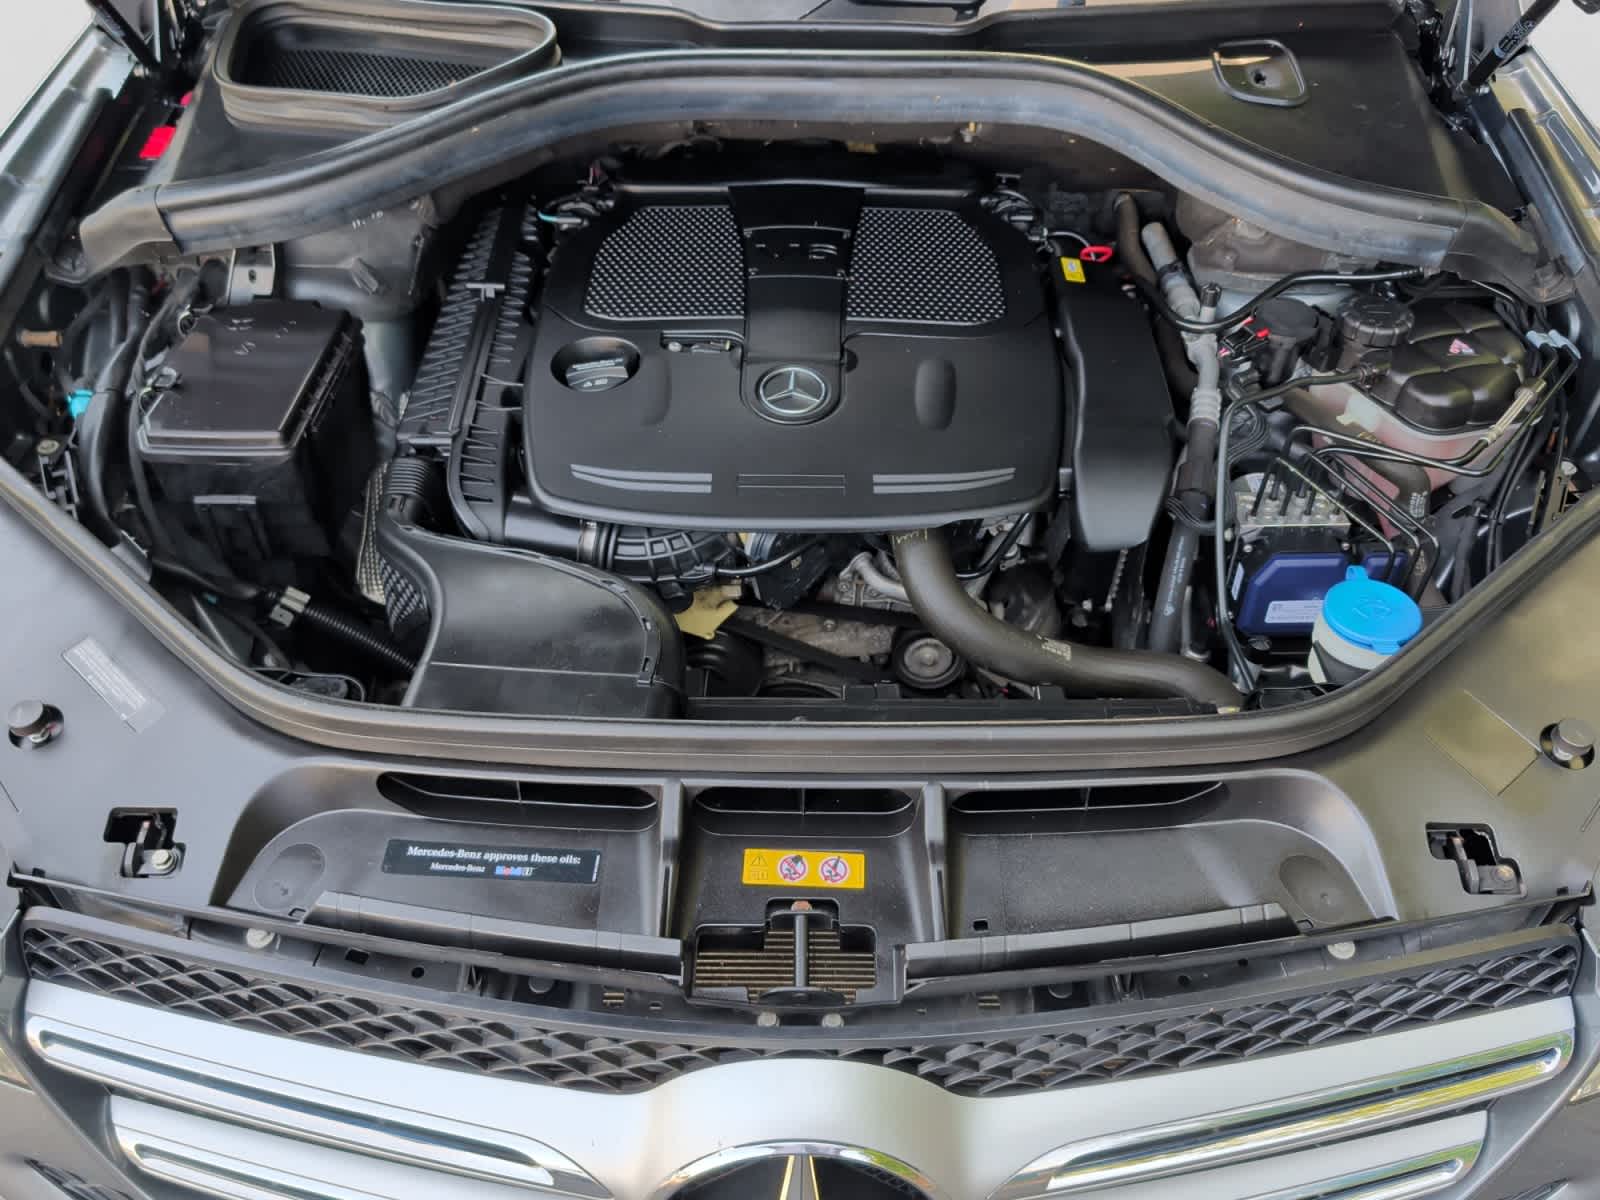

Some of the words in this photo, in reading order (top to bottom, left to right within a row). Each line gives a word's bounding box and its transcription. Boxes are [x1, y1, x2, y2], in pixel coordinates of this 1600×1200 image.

[406, 846, 482, 860] Mercedes-Benz
[484, 853, 529, 863] approves
[530, 853, 558, 863] these
[559, 855, 581, 864] oils:
[430, 862, 485, 873] Mercedes-Benz
